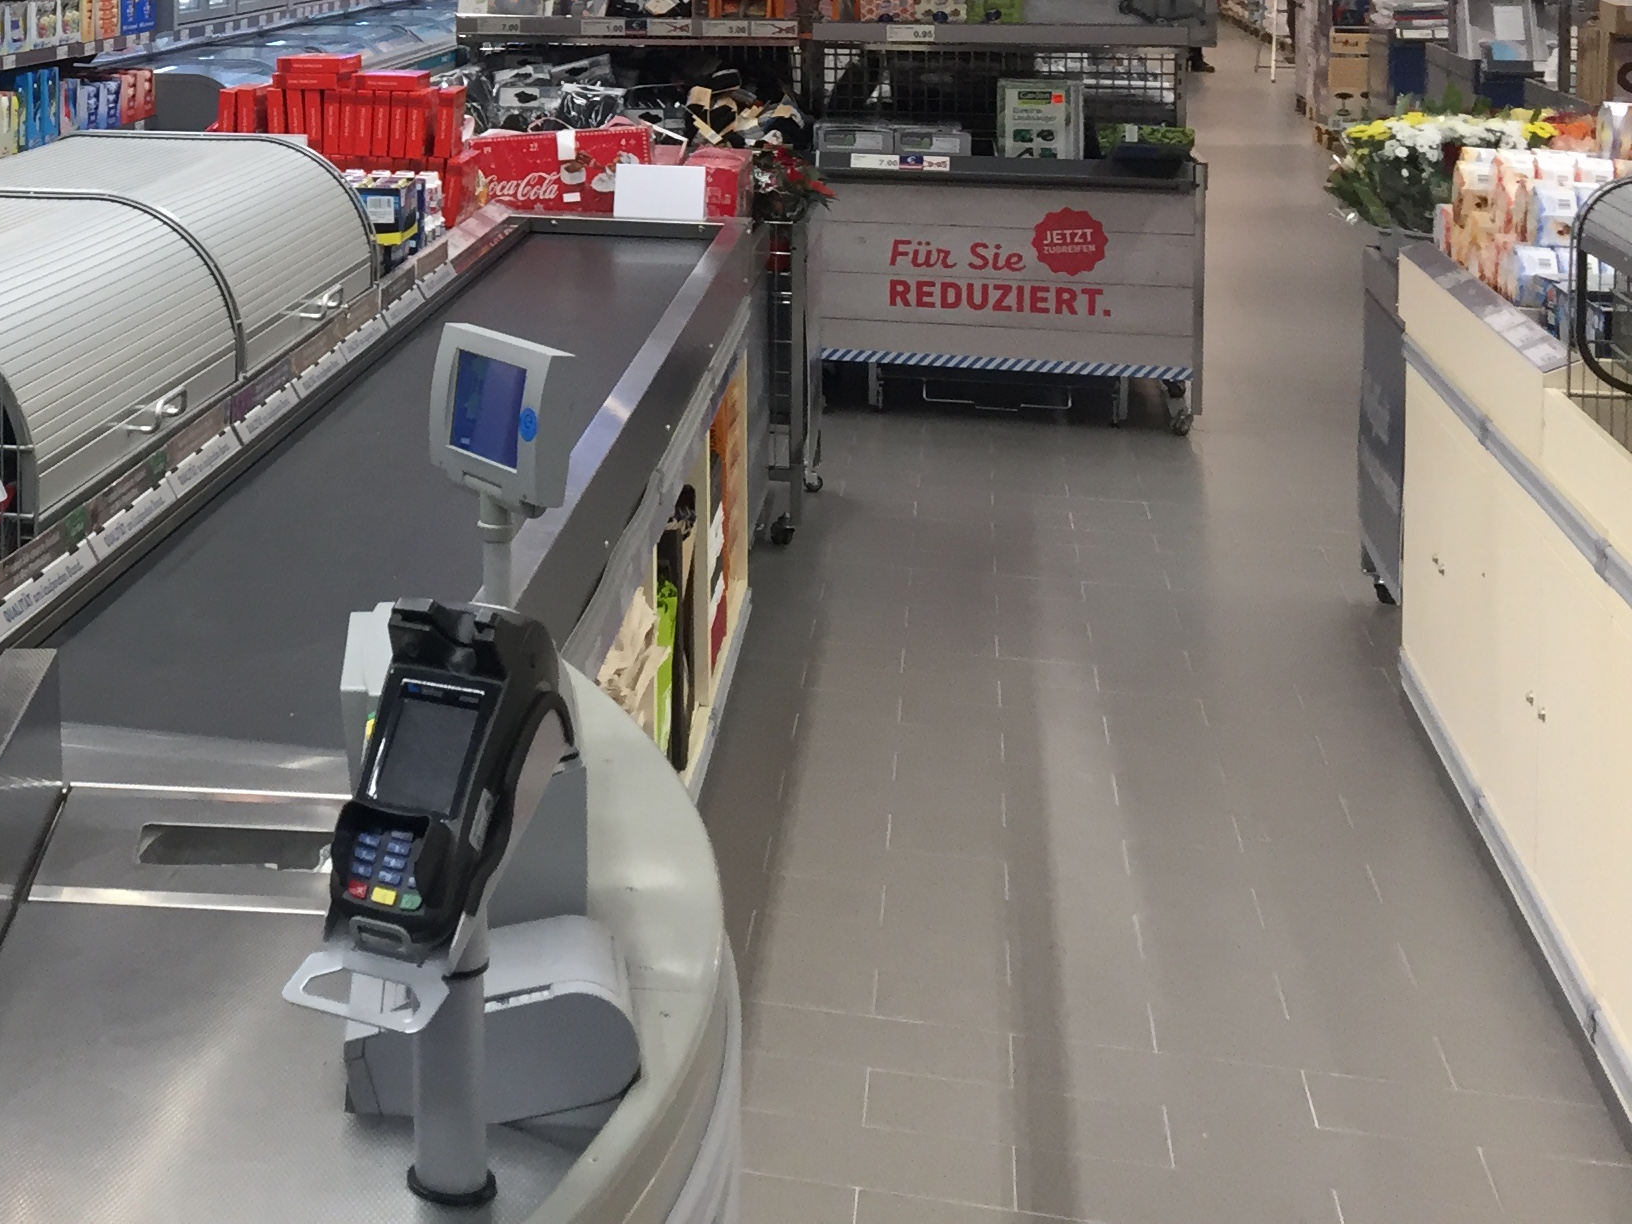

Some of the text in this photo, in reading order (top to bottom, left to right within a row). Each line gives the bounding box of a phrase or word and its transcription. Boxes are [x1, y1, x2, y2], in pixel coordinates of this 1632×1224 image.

[1042, 228, 1094, 245] JETZT
[889, 239, 1027, 272] Für Sie
[888, 279, 1112, 318] REDUZIERT.
